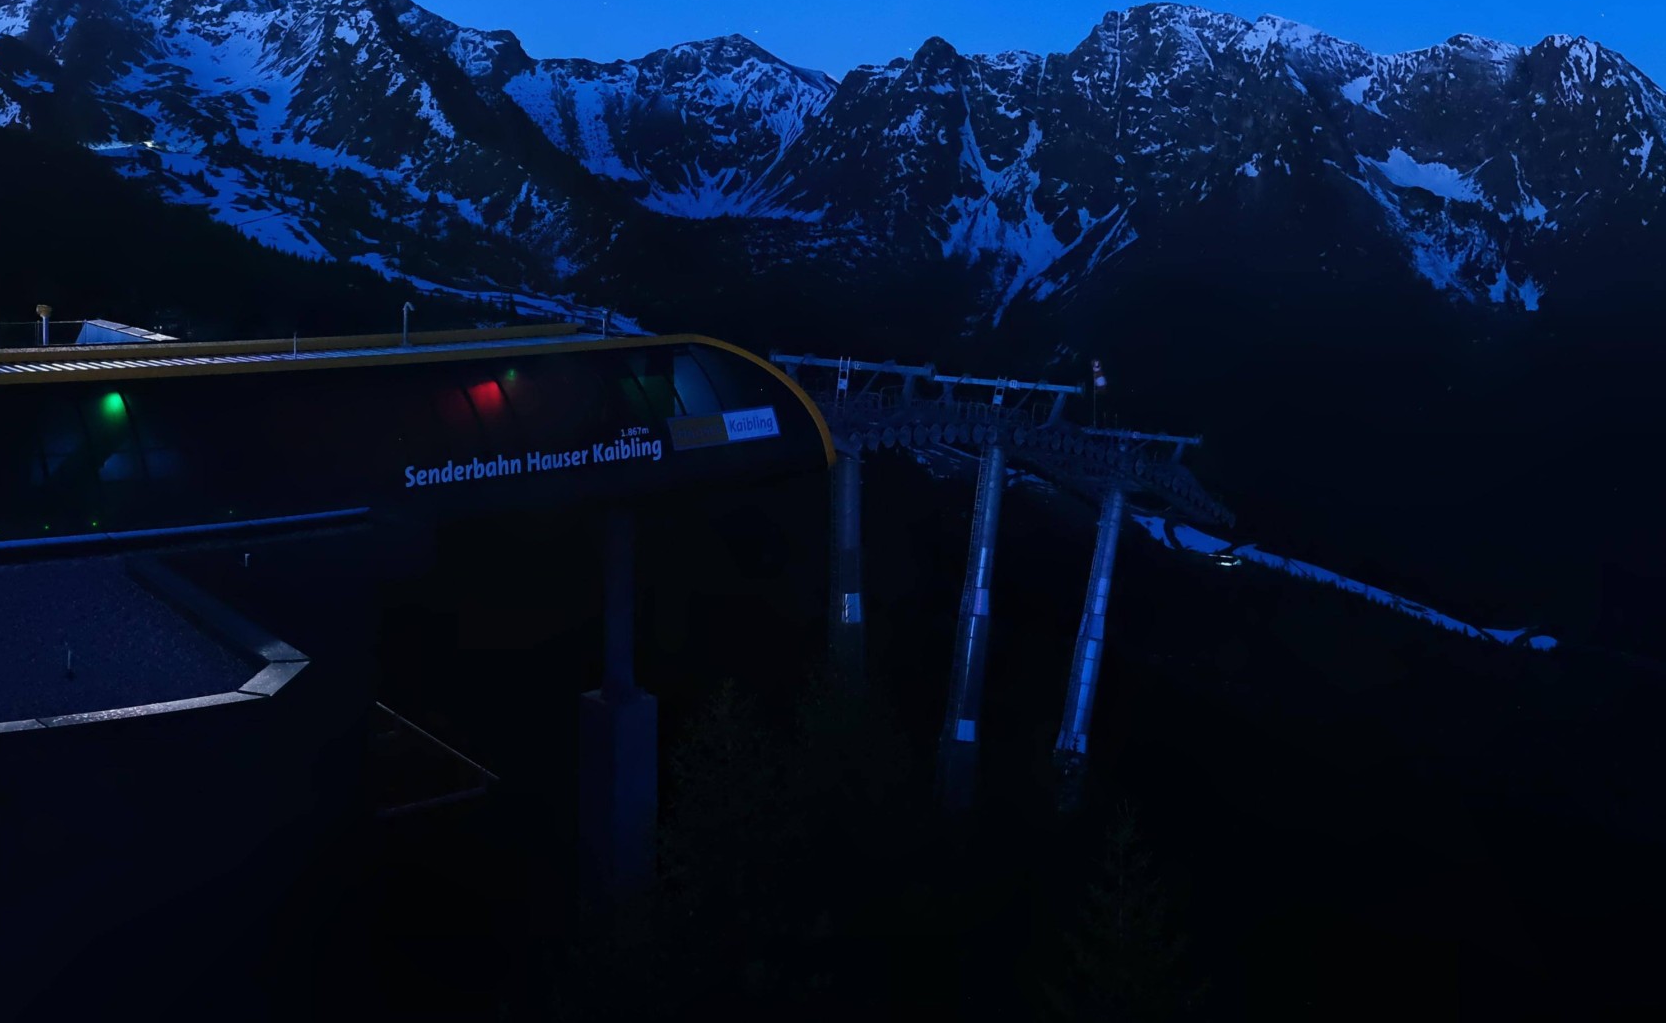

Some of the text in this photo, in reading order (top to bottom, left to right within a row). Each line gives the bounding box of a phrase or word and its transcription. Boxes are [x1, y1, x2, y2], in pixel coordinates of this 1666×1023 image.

[620, 426, 650, 437] 1.867m
[729, 416, 774, 433] Kaibling
[404, 436, 663, 488] Senderbahn Hauser Kaibling
